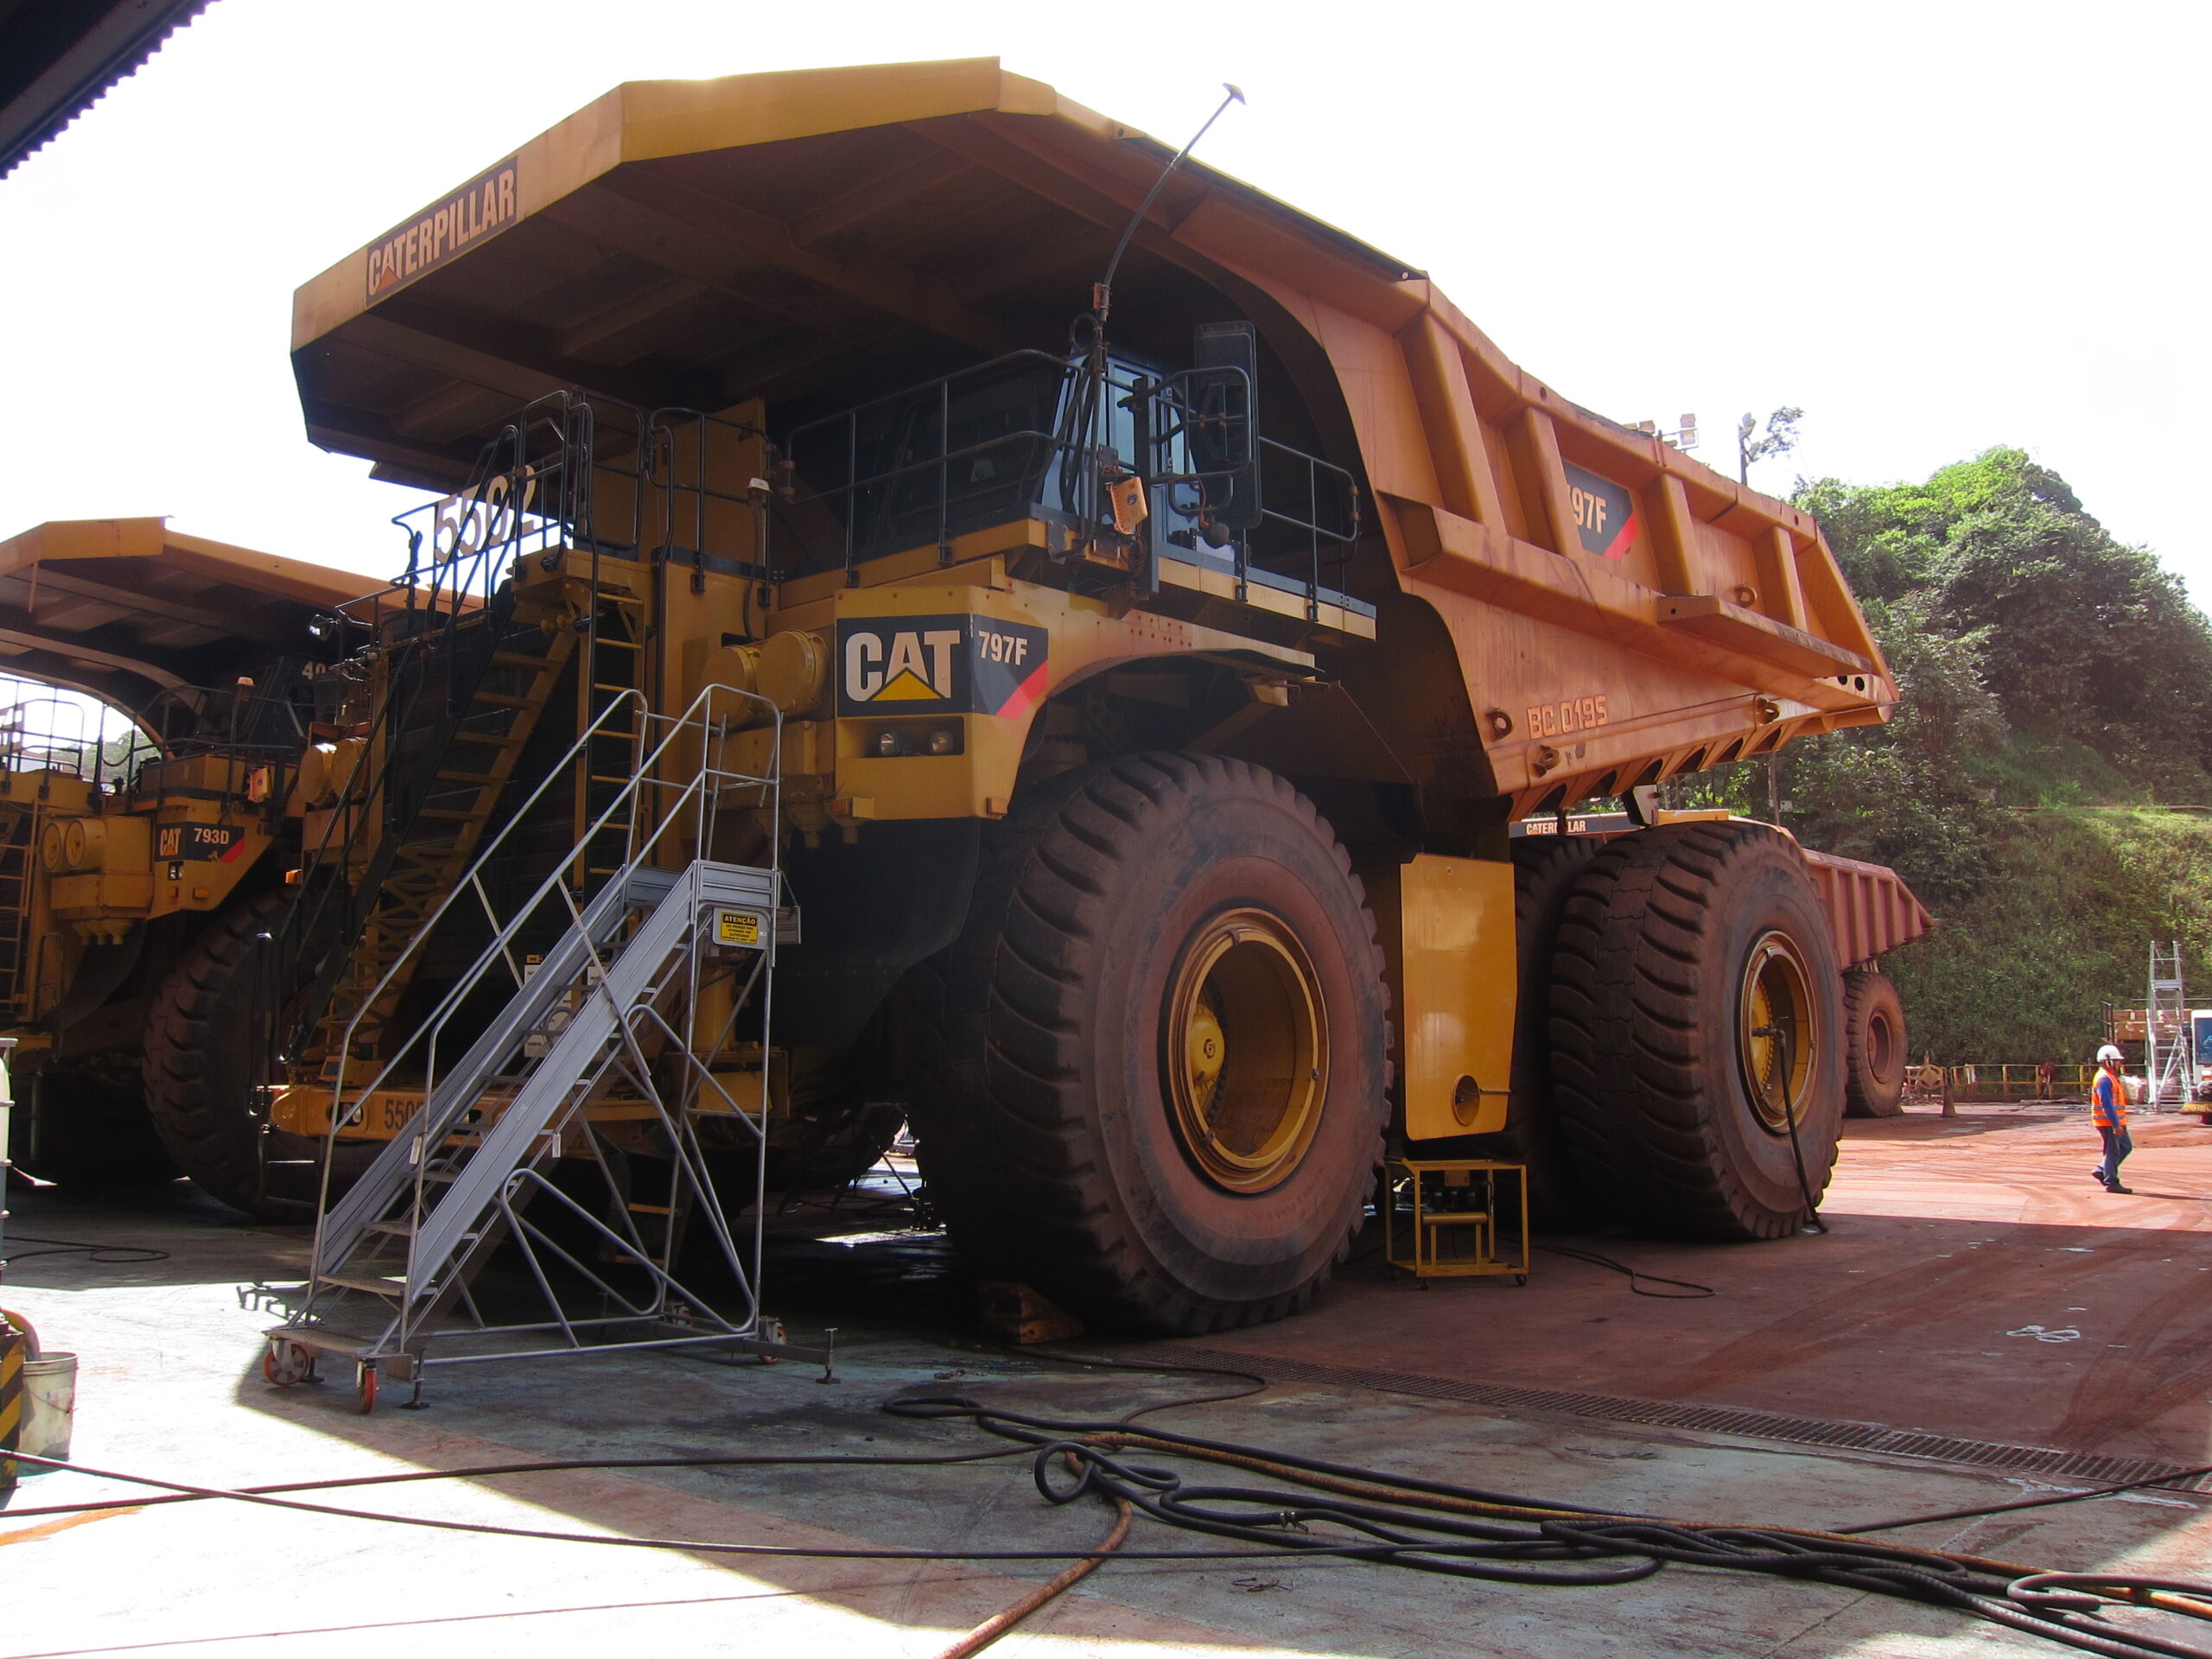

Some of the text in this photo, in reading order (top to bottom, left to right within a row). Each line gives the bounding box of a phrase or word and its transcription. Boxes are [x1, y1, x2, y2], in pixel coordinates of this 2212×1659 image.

[368, 168, 515, 296] CATERPILLAR
[1567, 484, 1608, 534] 97F
[845, 630, 961, 702] CAT
[978, 630, 1028, 666] 797F
[1527, 694, 1609, 740] BC 0195
[159, 828, 182, 856] CAT
[194, 827, 230, 845] 793D
[1526, 820, 1586, 836] CATERLAR
